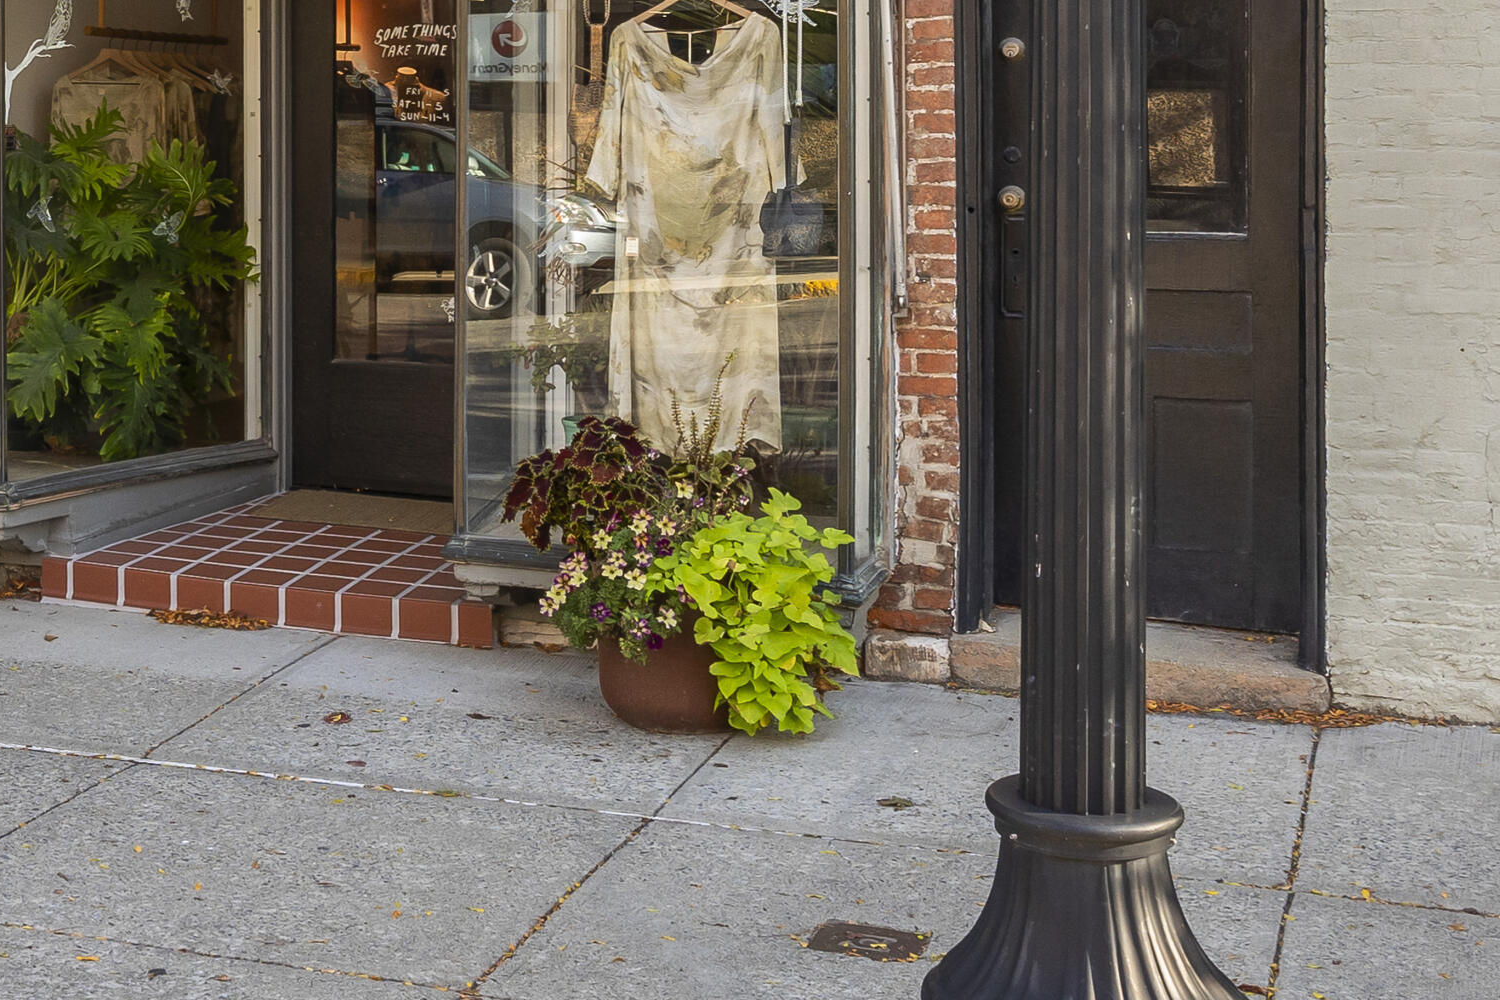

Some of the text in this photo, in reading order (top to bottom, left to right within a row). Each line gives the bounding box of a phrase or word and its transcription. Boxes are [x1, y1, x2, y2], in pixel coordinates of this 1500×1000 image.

[373, 24, 458, 45] SOME THINGS
[379, 43, 448, 58] TAKE TIME
[405, 87, 421, 95] FRI
